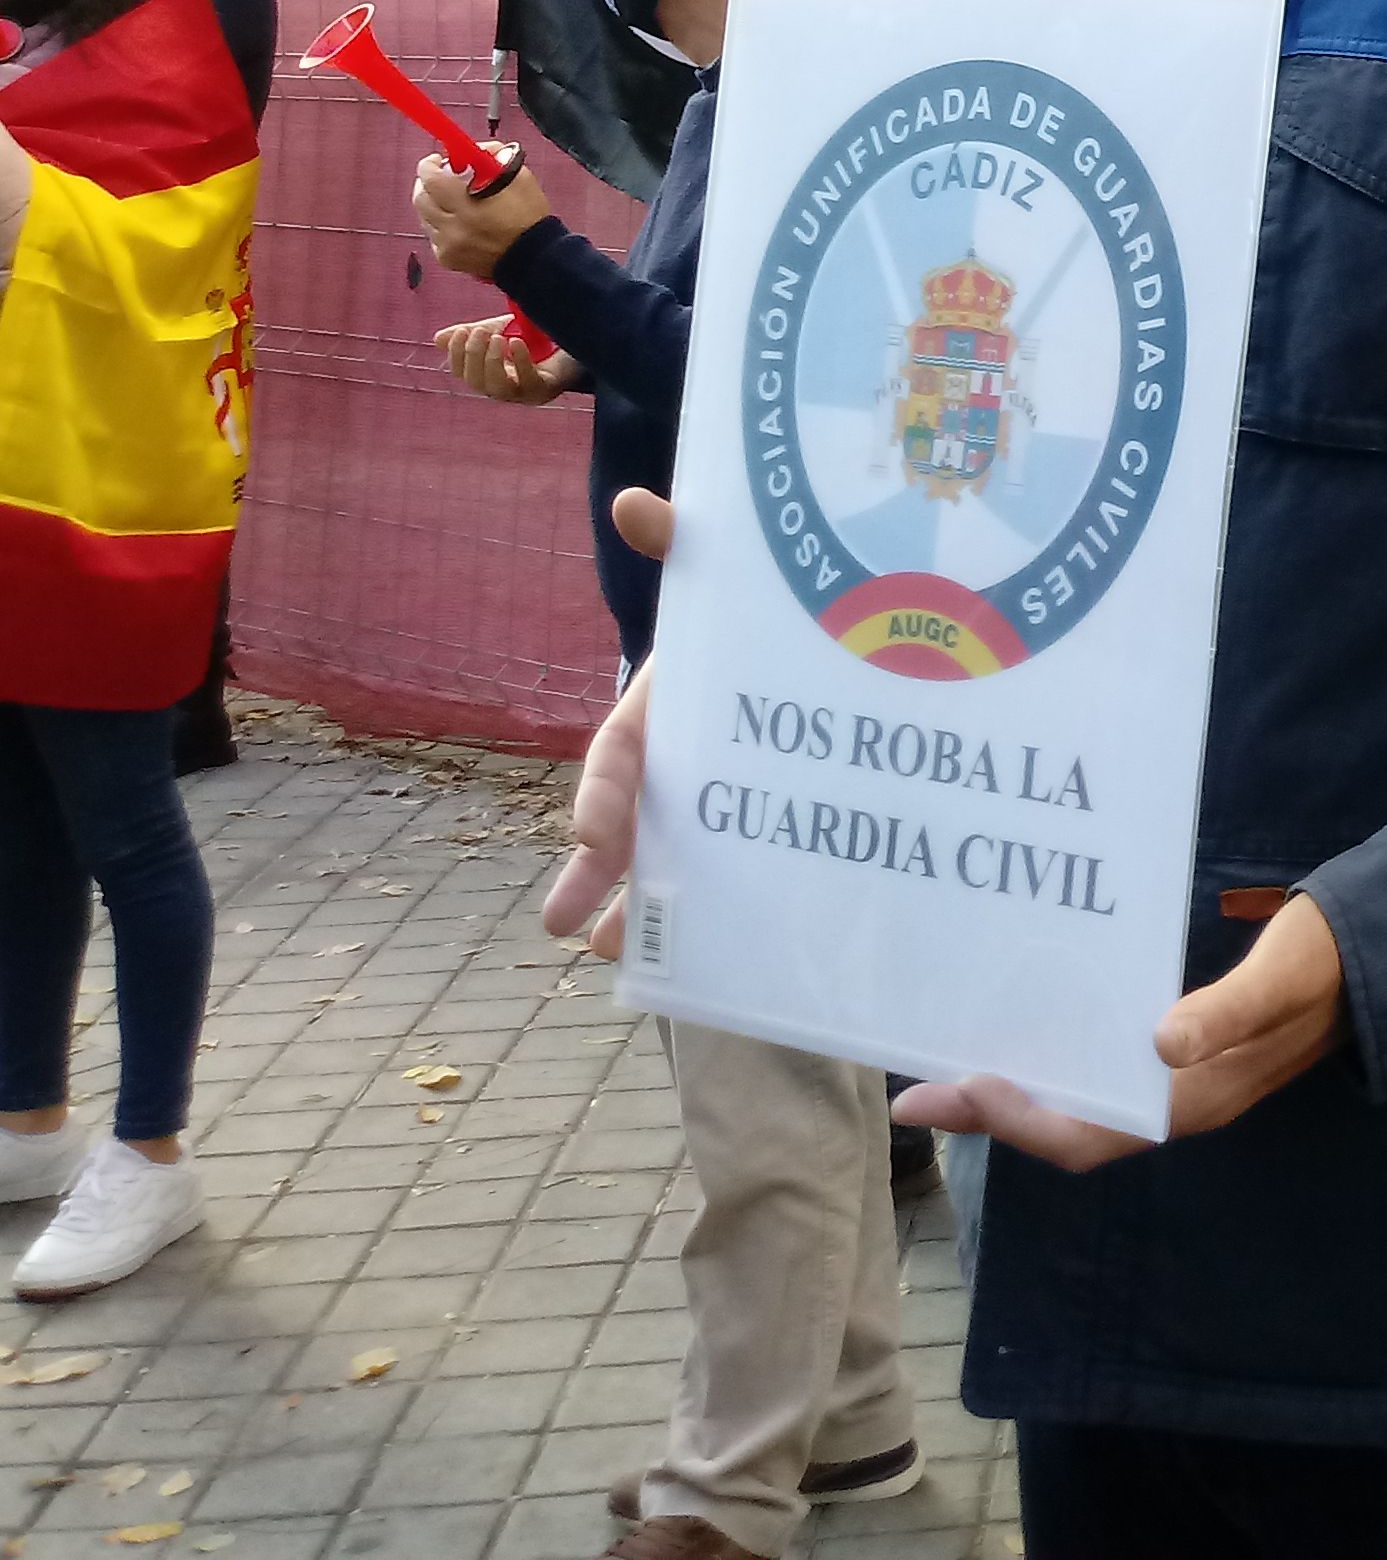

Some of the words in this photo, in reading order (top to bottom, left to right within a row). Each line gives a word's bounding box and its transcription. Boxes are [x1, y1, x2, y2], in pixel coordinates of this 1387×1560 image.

[793, 85, 992, 247] UNIFICADA
[910, 142, 1047, 212] CÁDIZ
[1009, 91, 1066, 141] DE
[1073, 137, 1163, 413] GUARDIAS
[757, 266, 842, 592] ASOCIACIÓN
[1023, 439, 1147, 626] CIVILES
[887, 613, 960, 650] AUGC
[731, 692, 836, 761] NOS
[849, 714, 1002, 794] ROBA
[1017, 745, 1094, 812] LA
[697, 780, 938, 880] GUARDIA
[956, 833, 1116, 917] CIVIL
